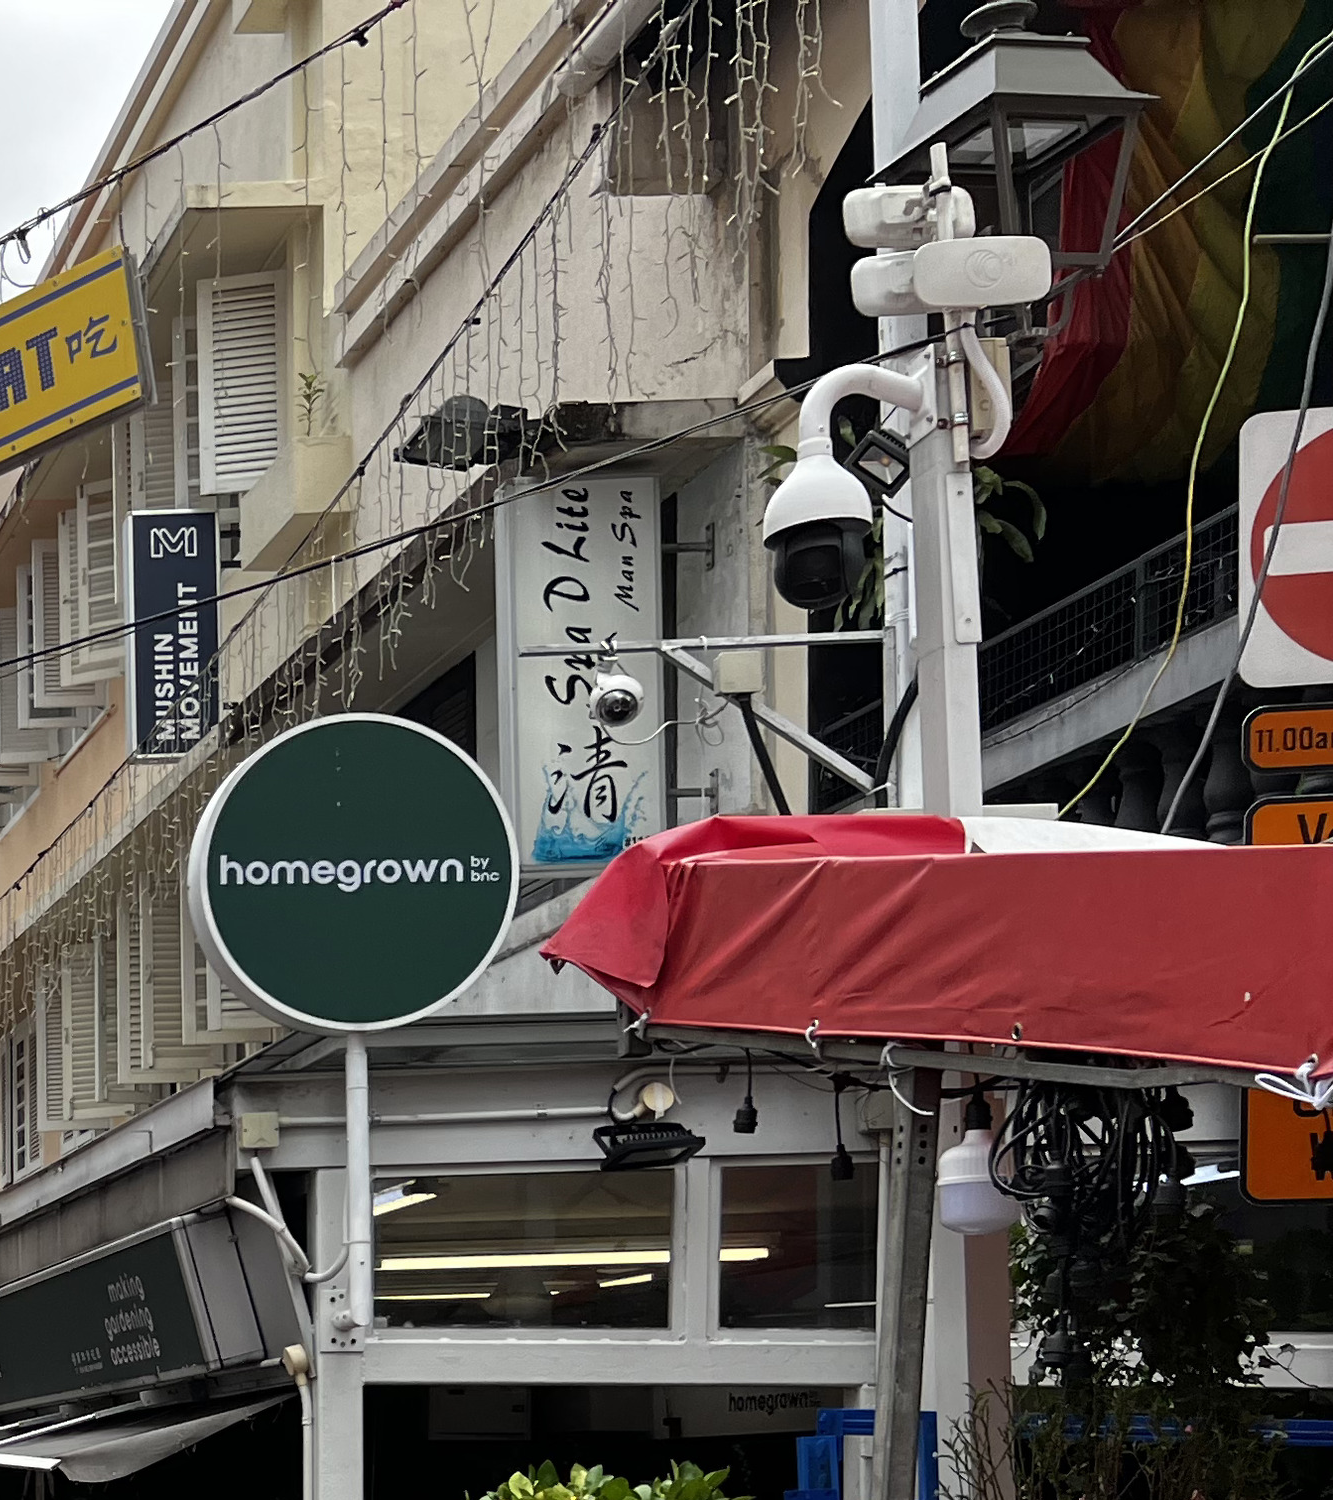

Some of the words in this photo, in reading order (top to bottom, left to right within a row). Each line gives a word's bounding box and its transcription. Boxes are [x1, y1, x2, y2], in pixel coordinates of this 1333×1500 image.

[67, 313, 118, 365] 吃
[541, 487, 591, 563] Lite
[611, 490, 642, 548] Spa
[543, 576, 590, 612] D
[614, 555, 640, 612] Man
[177, 582, 201, 740] MOVEMENT
[154, 633, 175, 740] MUSHIN
[1255, 726, 1333, 753] 11.00a
[548, 725, 628, 823] 清
[219, 855, 464, 893] homegrown
[470, 855, 489, 871] by
[470, 869, 501, 883] bnc
[107, 1272, 145, 1302] making
[104, 1303, 154, 1341] gardening
[110, 1333, 161, 1366] accessible
[728, 1391, 809, 1415] homegrown
